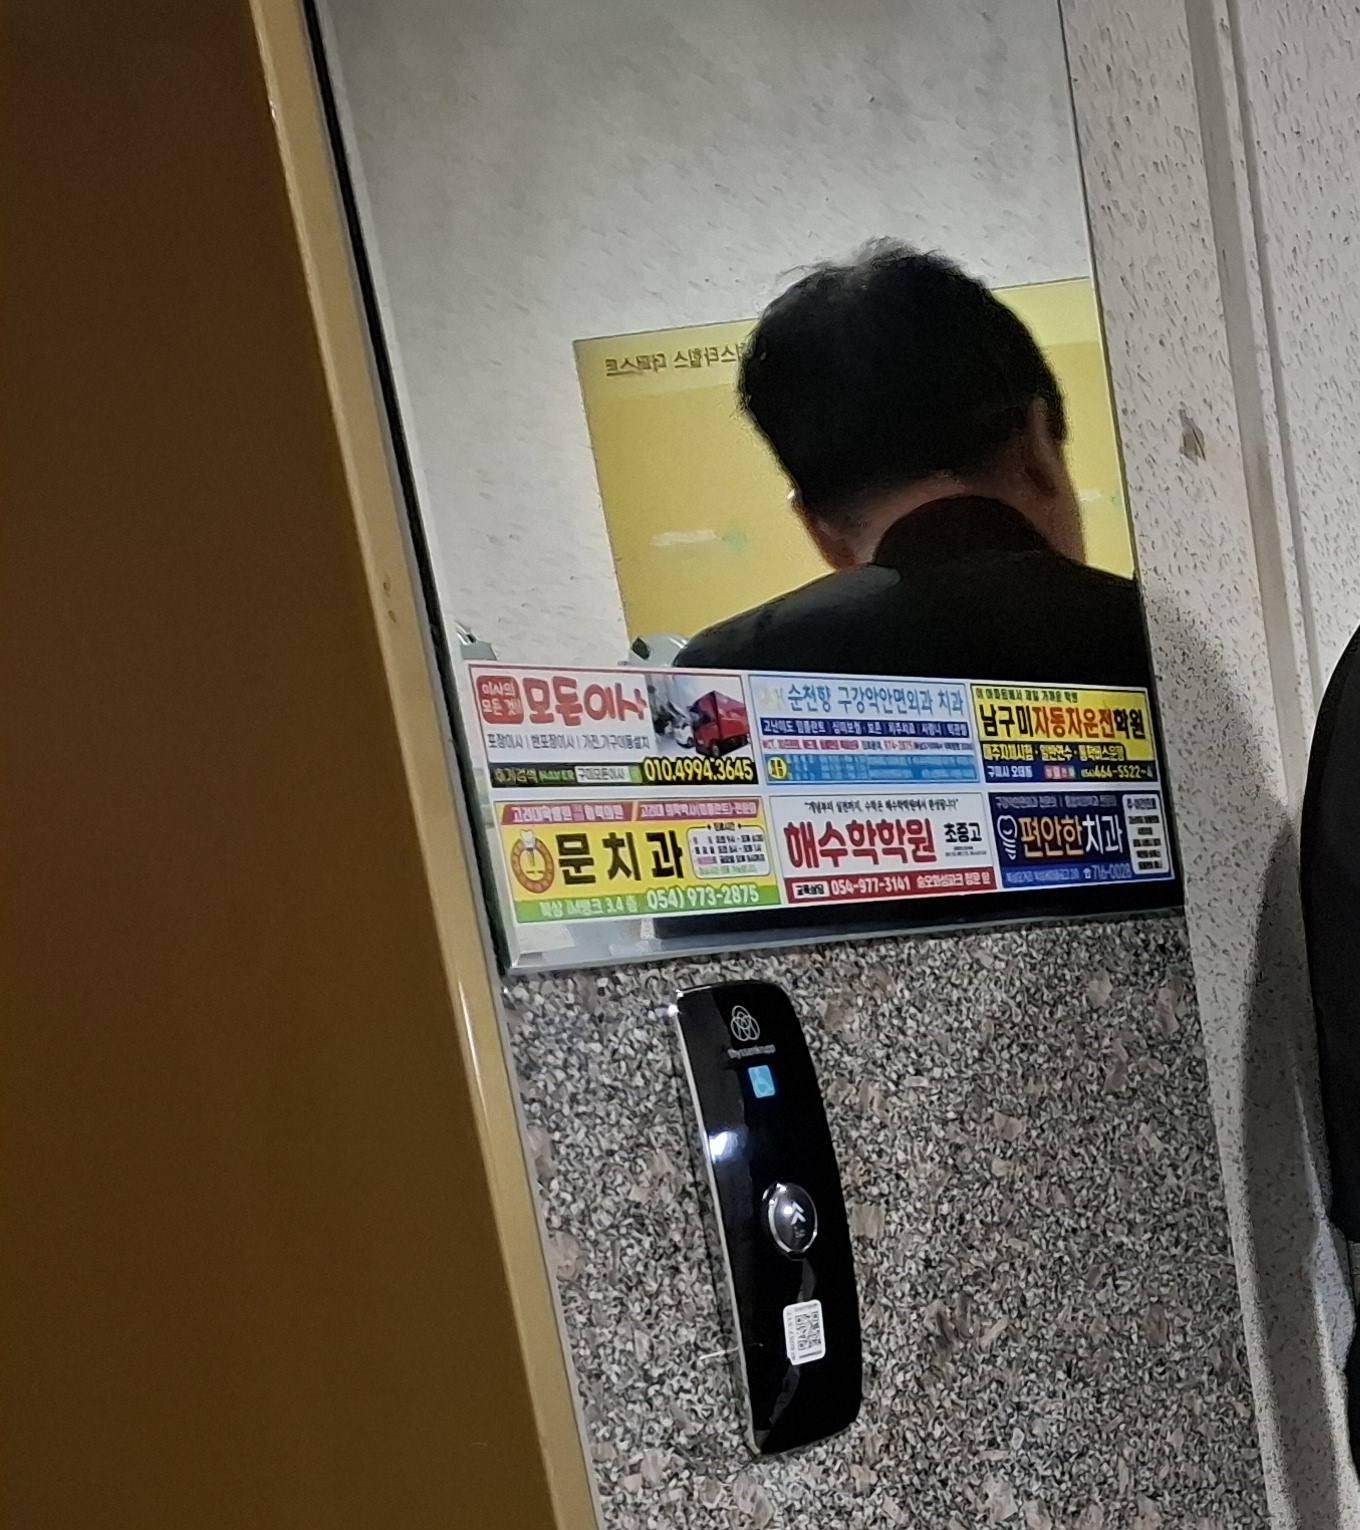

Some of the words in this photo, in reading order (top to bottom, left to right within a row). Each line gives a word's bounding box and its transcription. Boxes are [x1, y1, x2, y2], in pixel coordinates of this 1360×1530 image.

[788, 684, 831, 712] 순천향
[838, 687, 933, 716] 구강악안면외과
[938, 689, 964, 716] 치과
[979, 704, 1146, 739] 남구미자동차운전학원
[784, 818, 937, 868] 해수학학원
[944, 822, 983, 843] 초중고
[1018, 814, 1123, 858] 편안한치과
[555, 831, 684, 885] 문치과
